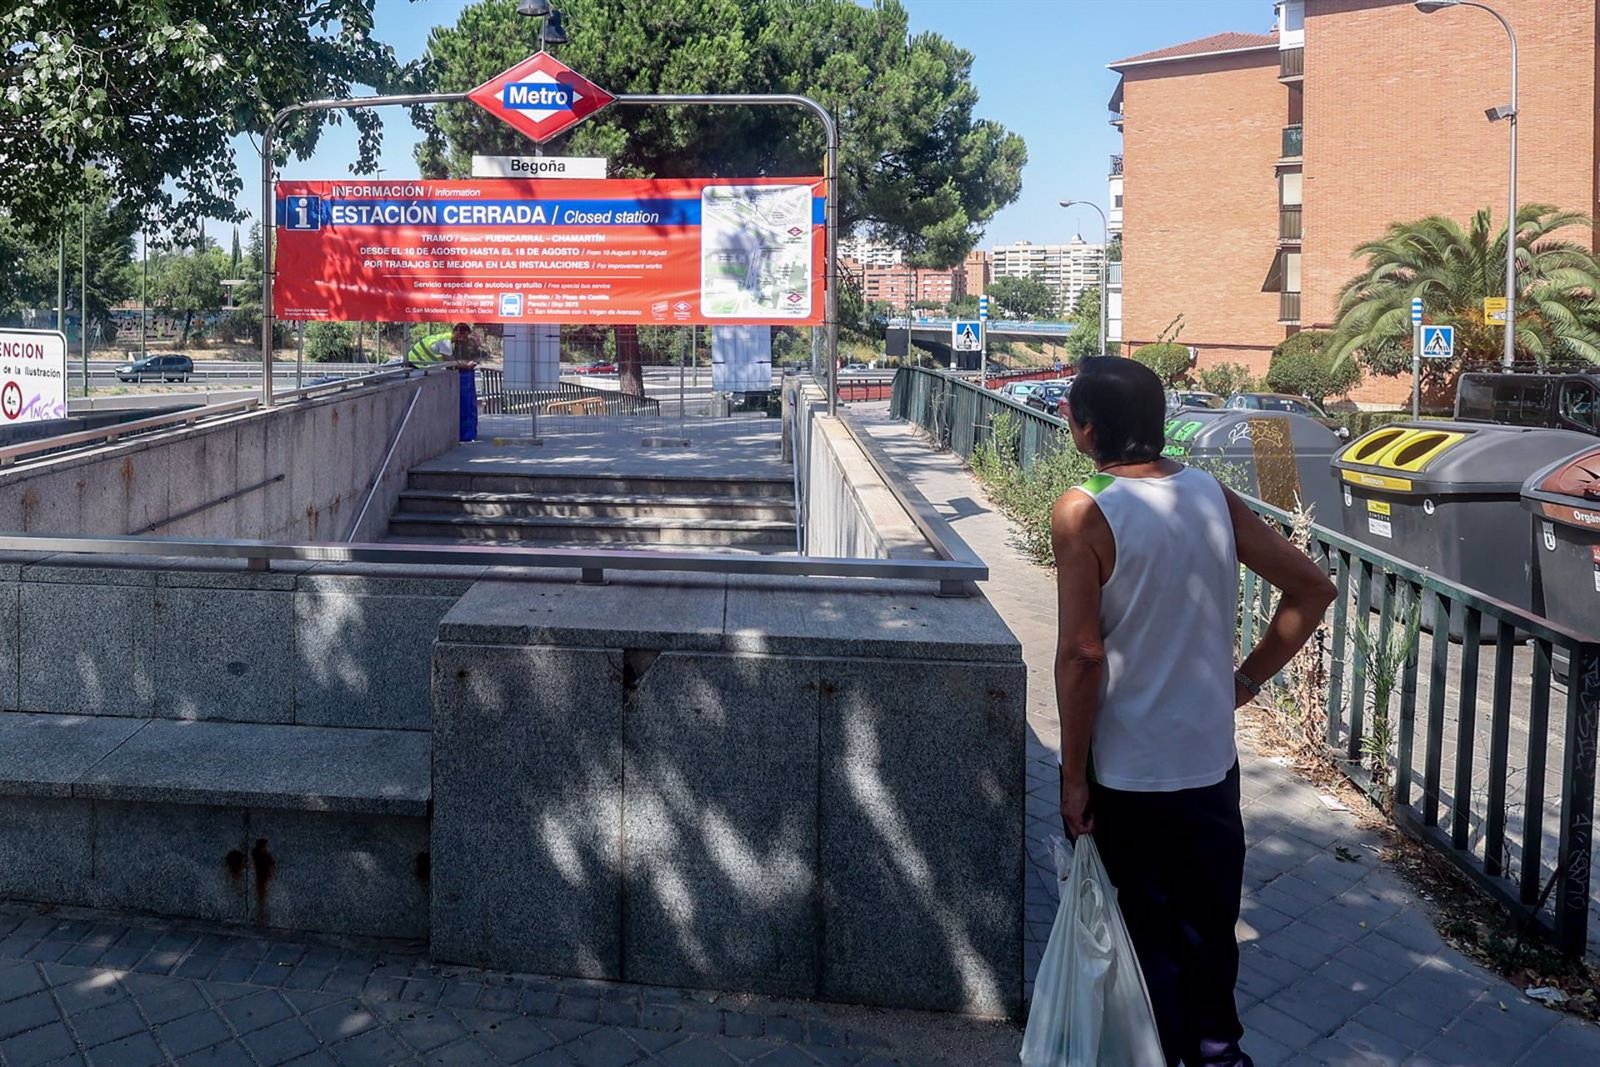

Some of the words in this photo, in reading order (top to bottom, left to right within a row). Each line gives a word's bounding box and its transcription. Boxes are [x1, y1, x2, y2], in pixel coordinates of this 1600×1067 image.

[509, 86, 568, 105] Metro
[511, 160, 566, 174] Begoña
[332, 183, 424, 197] INFORMACIÓN
[435, 188, 481, 197] Information
[332, 201, 437, 224] ESTACIÓN
[443, 206, 546, 224] CERRADA
[564, 210, 612, 224] Closed
[614, 210, 659, 224] station
[421, 234, 452, 242] TRAMO
[485, 234, 544, 243] FUENCARRAL
[551, 232, 605, 242] CHAMARTÍN
[360, 247, 390, 256] DESDE
[391, 247, 402, 256] EL
[416, 247, 429, 256] DE
[430, 247, 468, 256] AGOSTO
[470, 247, 499, 256] HASTA
[501, 247, 512, 256] EL
[527, 247, 539, 256] DE
[541, 247, 580, 256] AGOSTO
[364, 260, 383, 269] POR
[384, 260, 431, 269] TRABAJOS
[433, 260, 445, 269] DE
[447, 260, 483, 269] MEJORA
[486, 260, 498, 269] EN
[500, 260, 517, 269] LAS
[519, 260, 590, 269] INSTALACIONES
[0, 342, 43, 359] NCION
[3, 366, 11, 374] de
[15, 365, 21, 375] la
